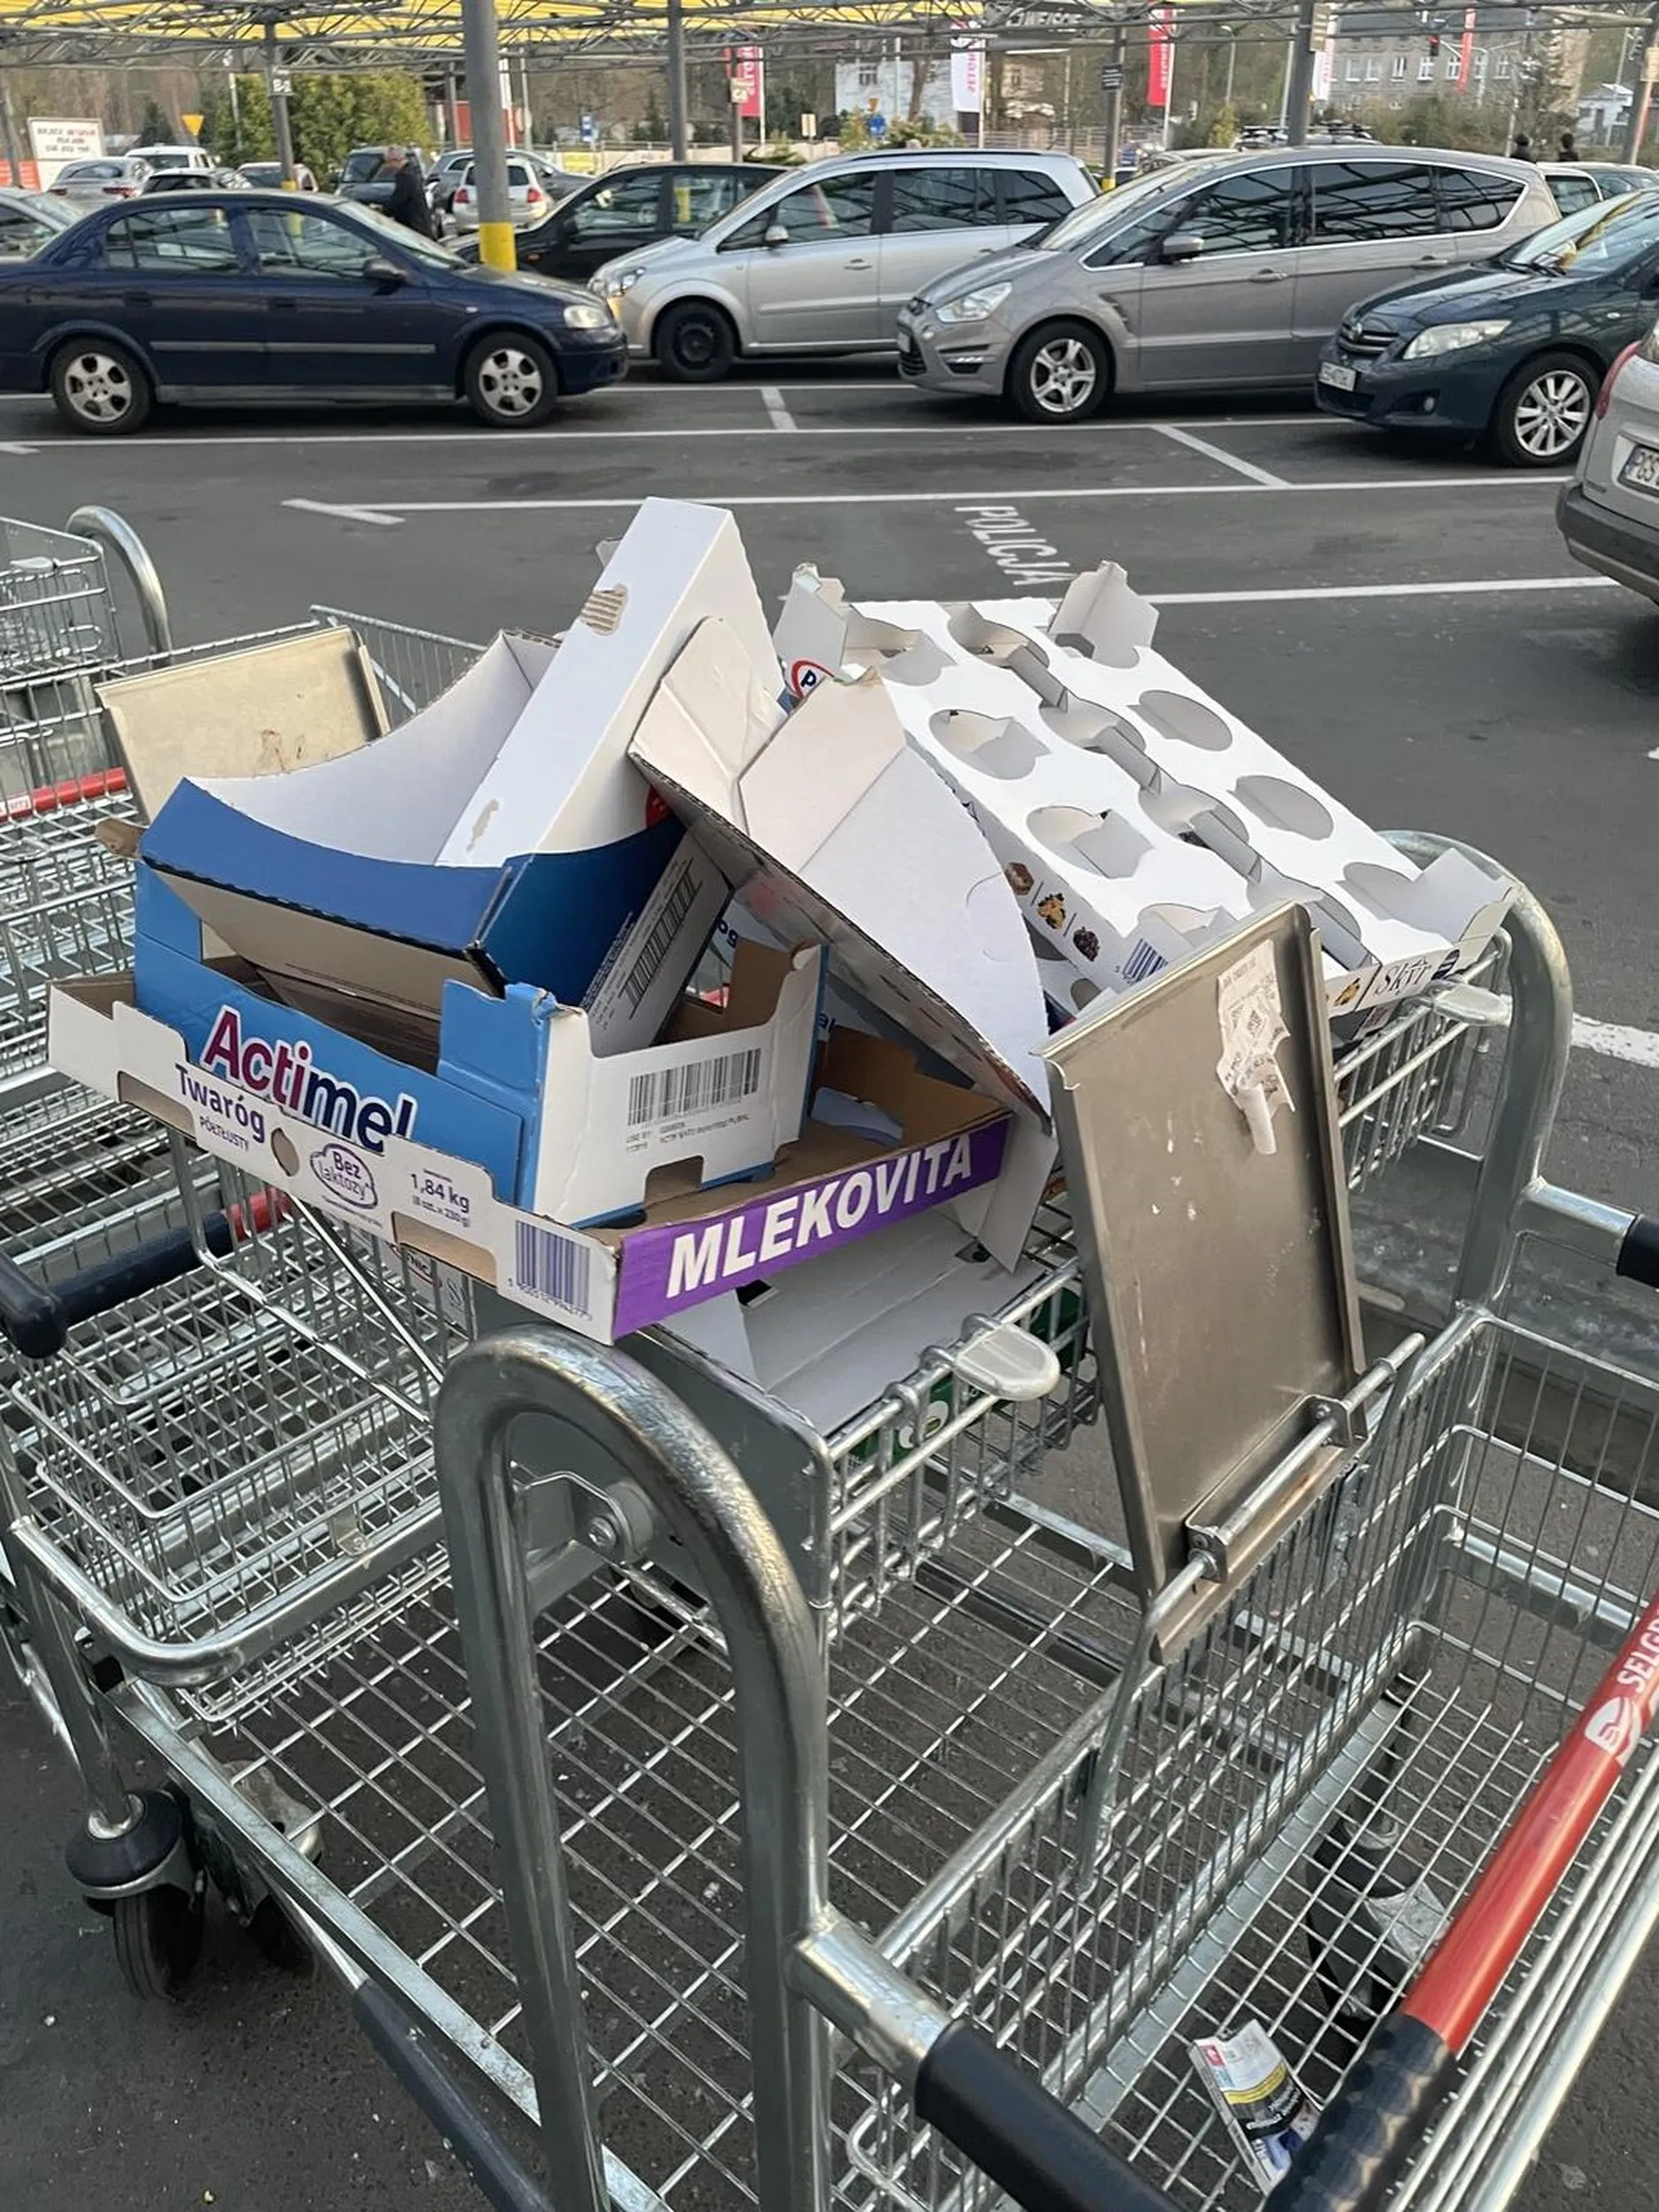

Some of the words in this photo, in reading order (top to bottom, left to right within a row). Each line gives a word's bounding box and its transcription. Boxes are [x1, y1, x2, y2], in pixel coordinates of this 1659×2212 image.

[954, 505, 1078, 586] POLICJA
[174, 1063, 266, 1144] Twaróg
[201, 1007, 416, 1153] Actimel
[332, 1150, 363, 1180] Bez
[449, 1186, 471, 1214] kg
[665, 1133, 972, 1299] MLEKOVITA
